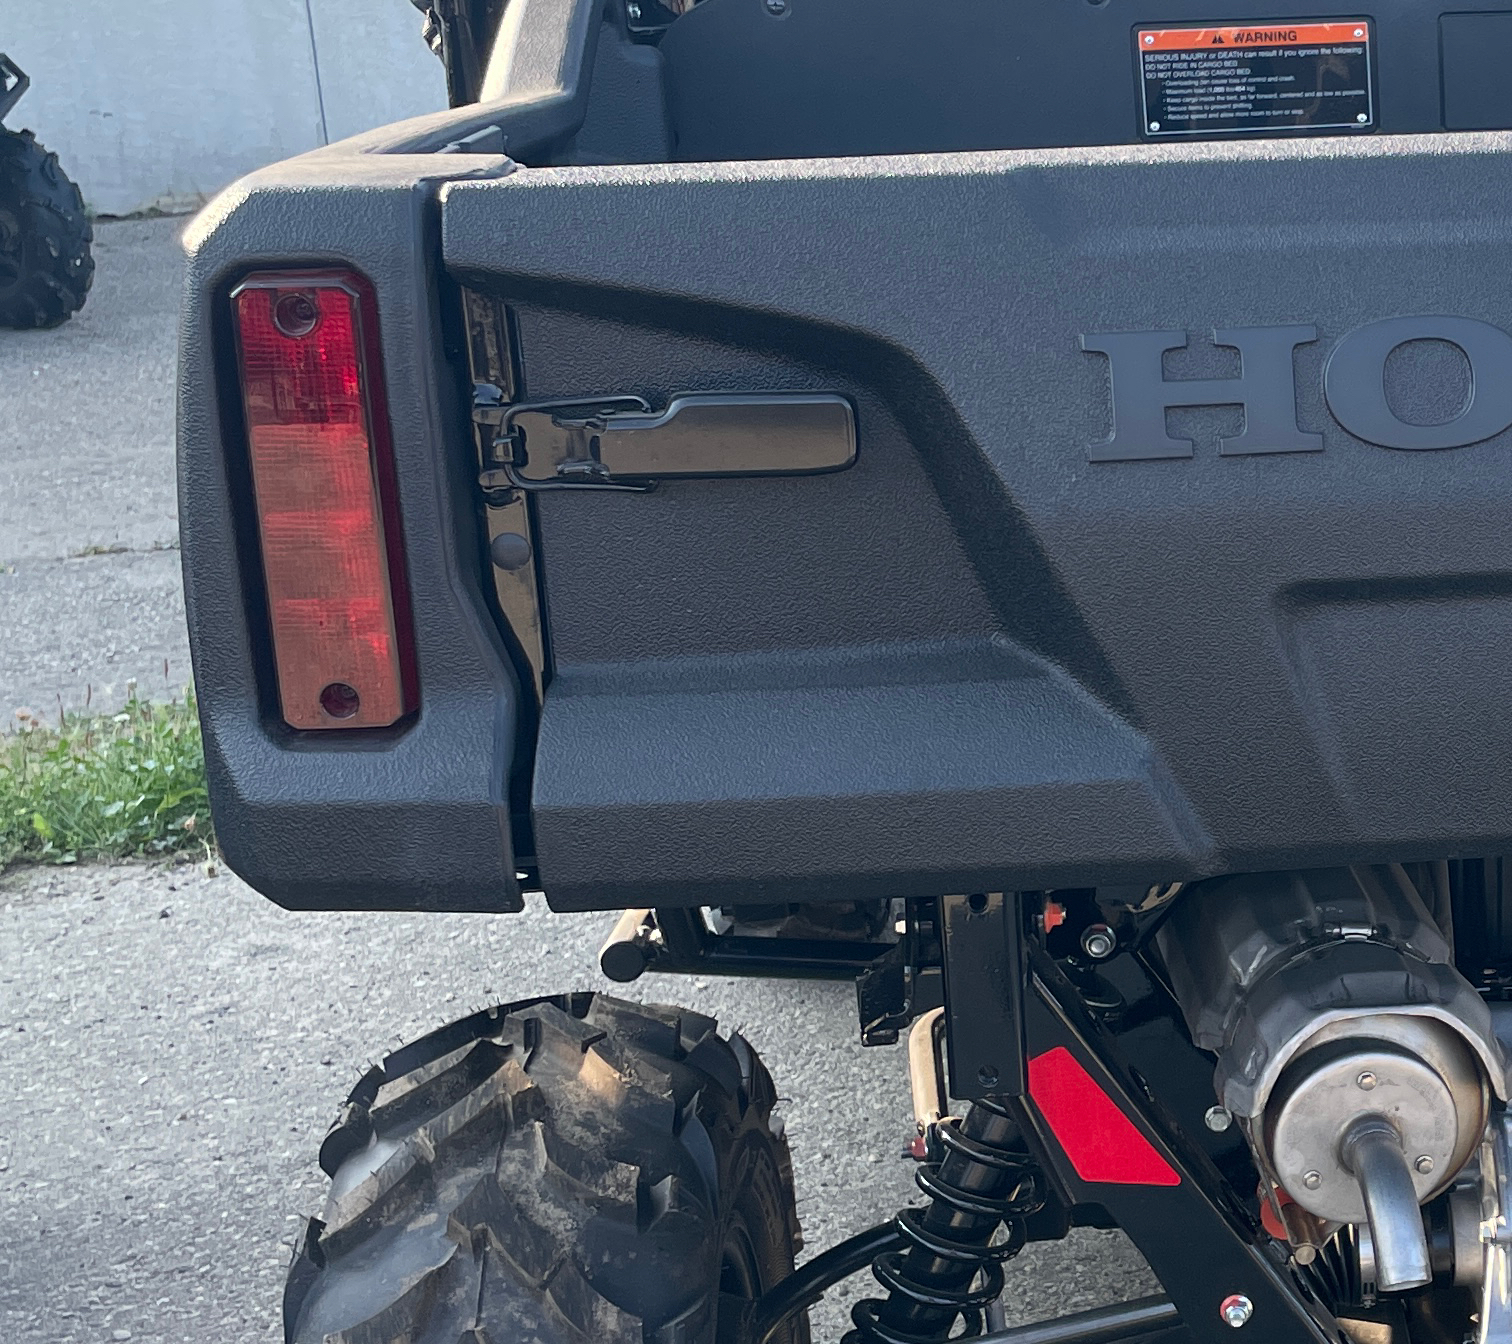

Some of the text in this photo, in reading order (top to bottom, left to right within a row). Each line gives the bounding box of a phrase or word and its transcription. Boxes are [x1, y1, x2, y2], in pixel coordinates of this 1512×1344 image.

[1233, 30, 1297, 44] WARNING
[1144, 53, 1179, 62] SERIOUS
[1180, 52, 1208, 61] INJURY
[1217, 51, 1243, 59] DEATH
[1284, 50, 1297, 58] you
[1198, 60, 1223, 68] CARGO
[1172, 70, 1210, 78] OVERLOAD
